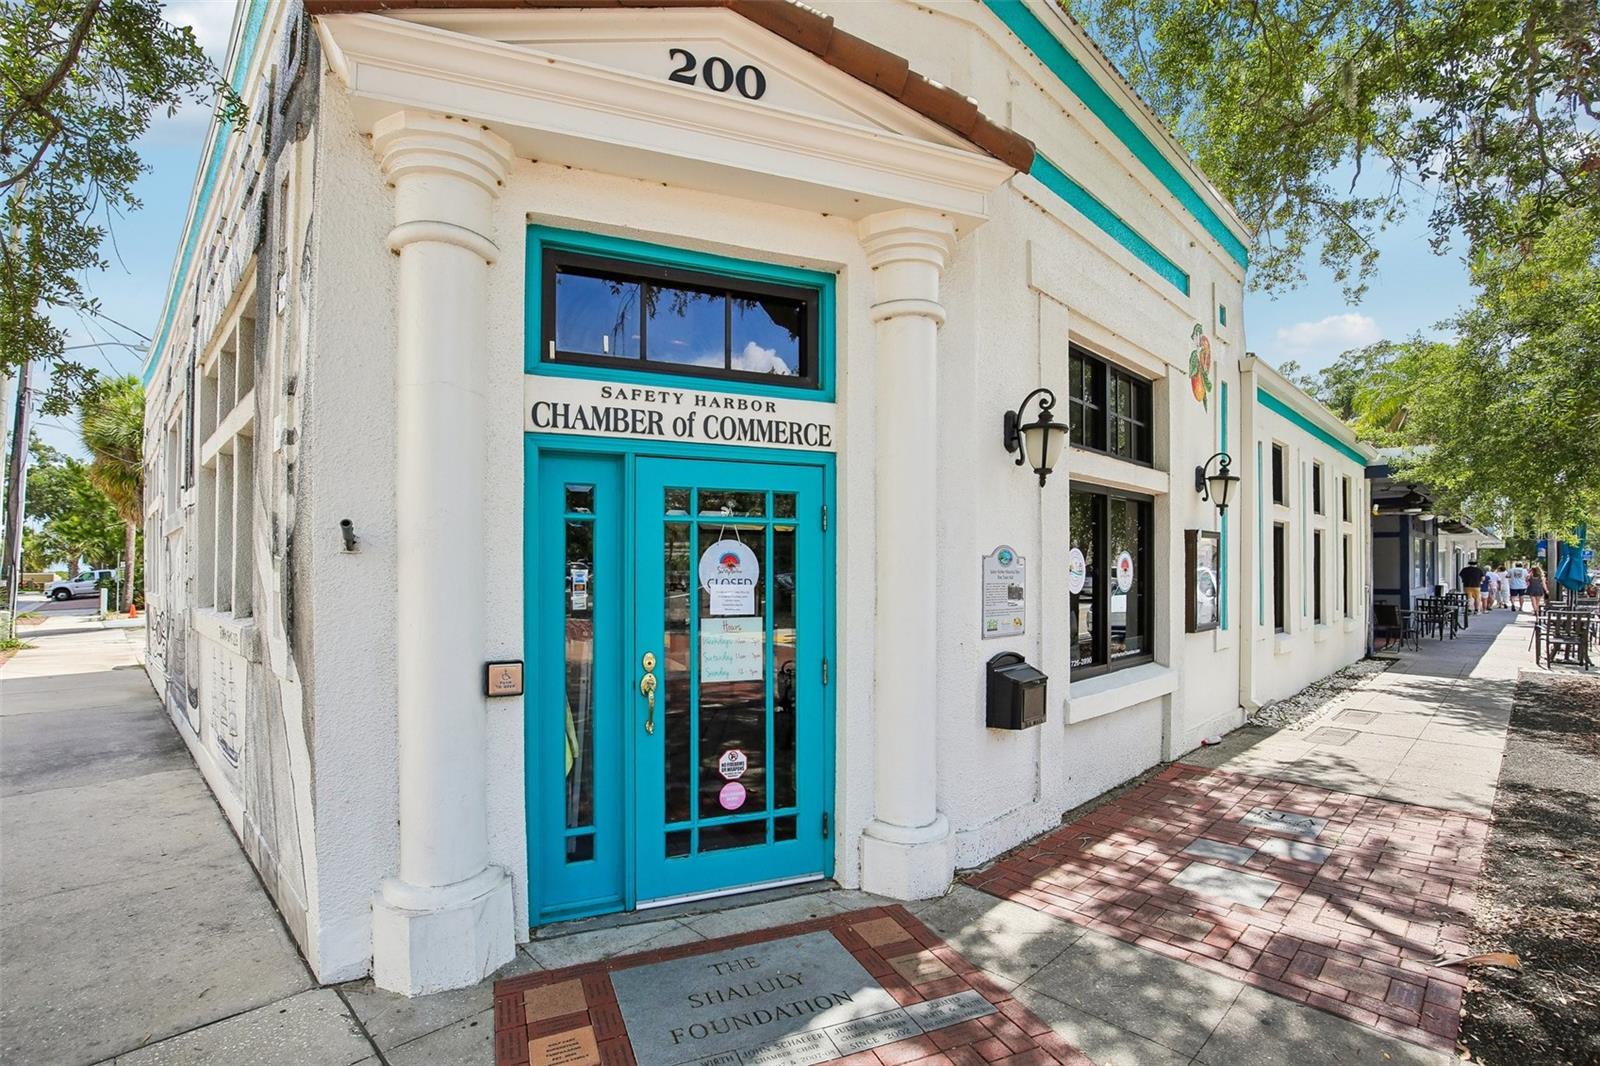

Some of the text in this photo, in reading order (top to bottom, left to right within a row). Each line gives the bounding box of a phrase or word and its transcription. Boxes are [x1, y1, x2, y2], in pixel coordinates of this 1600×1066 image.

[668, 48, 766, 100] 200
[601, 386, 776, 413] SAFETY HARBOR
[531, 401, 832, 447] CHAMBER of COMMERCE
[707, 956, 760, 976] THE
[688, 972, 803, 1008] SHALULY
[669, 990, 854, 1044] FOUNDATION
[873, 1012, 903, 1024] WIRTH
[850, 1028, 912, 1050] SINCE 2002
